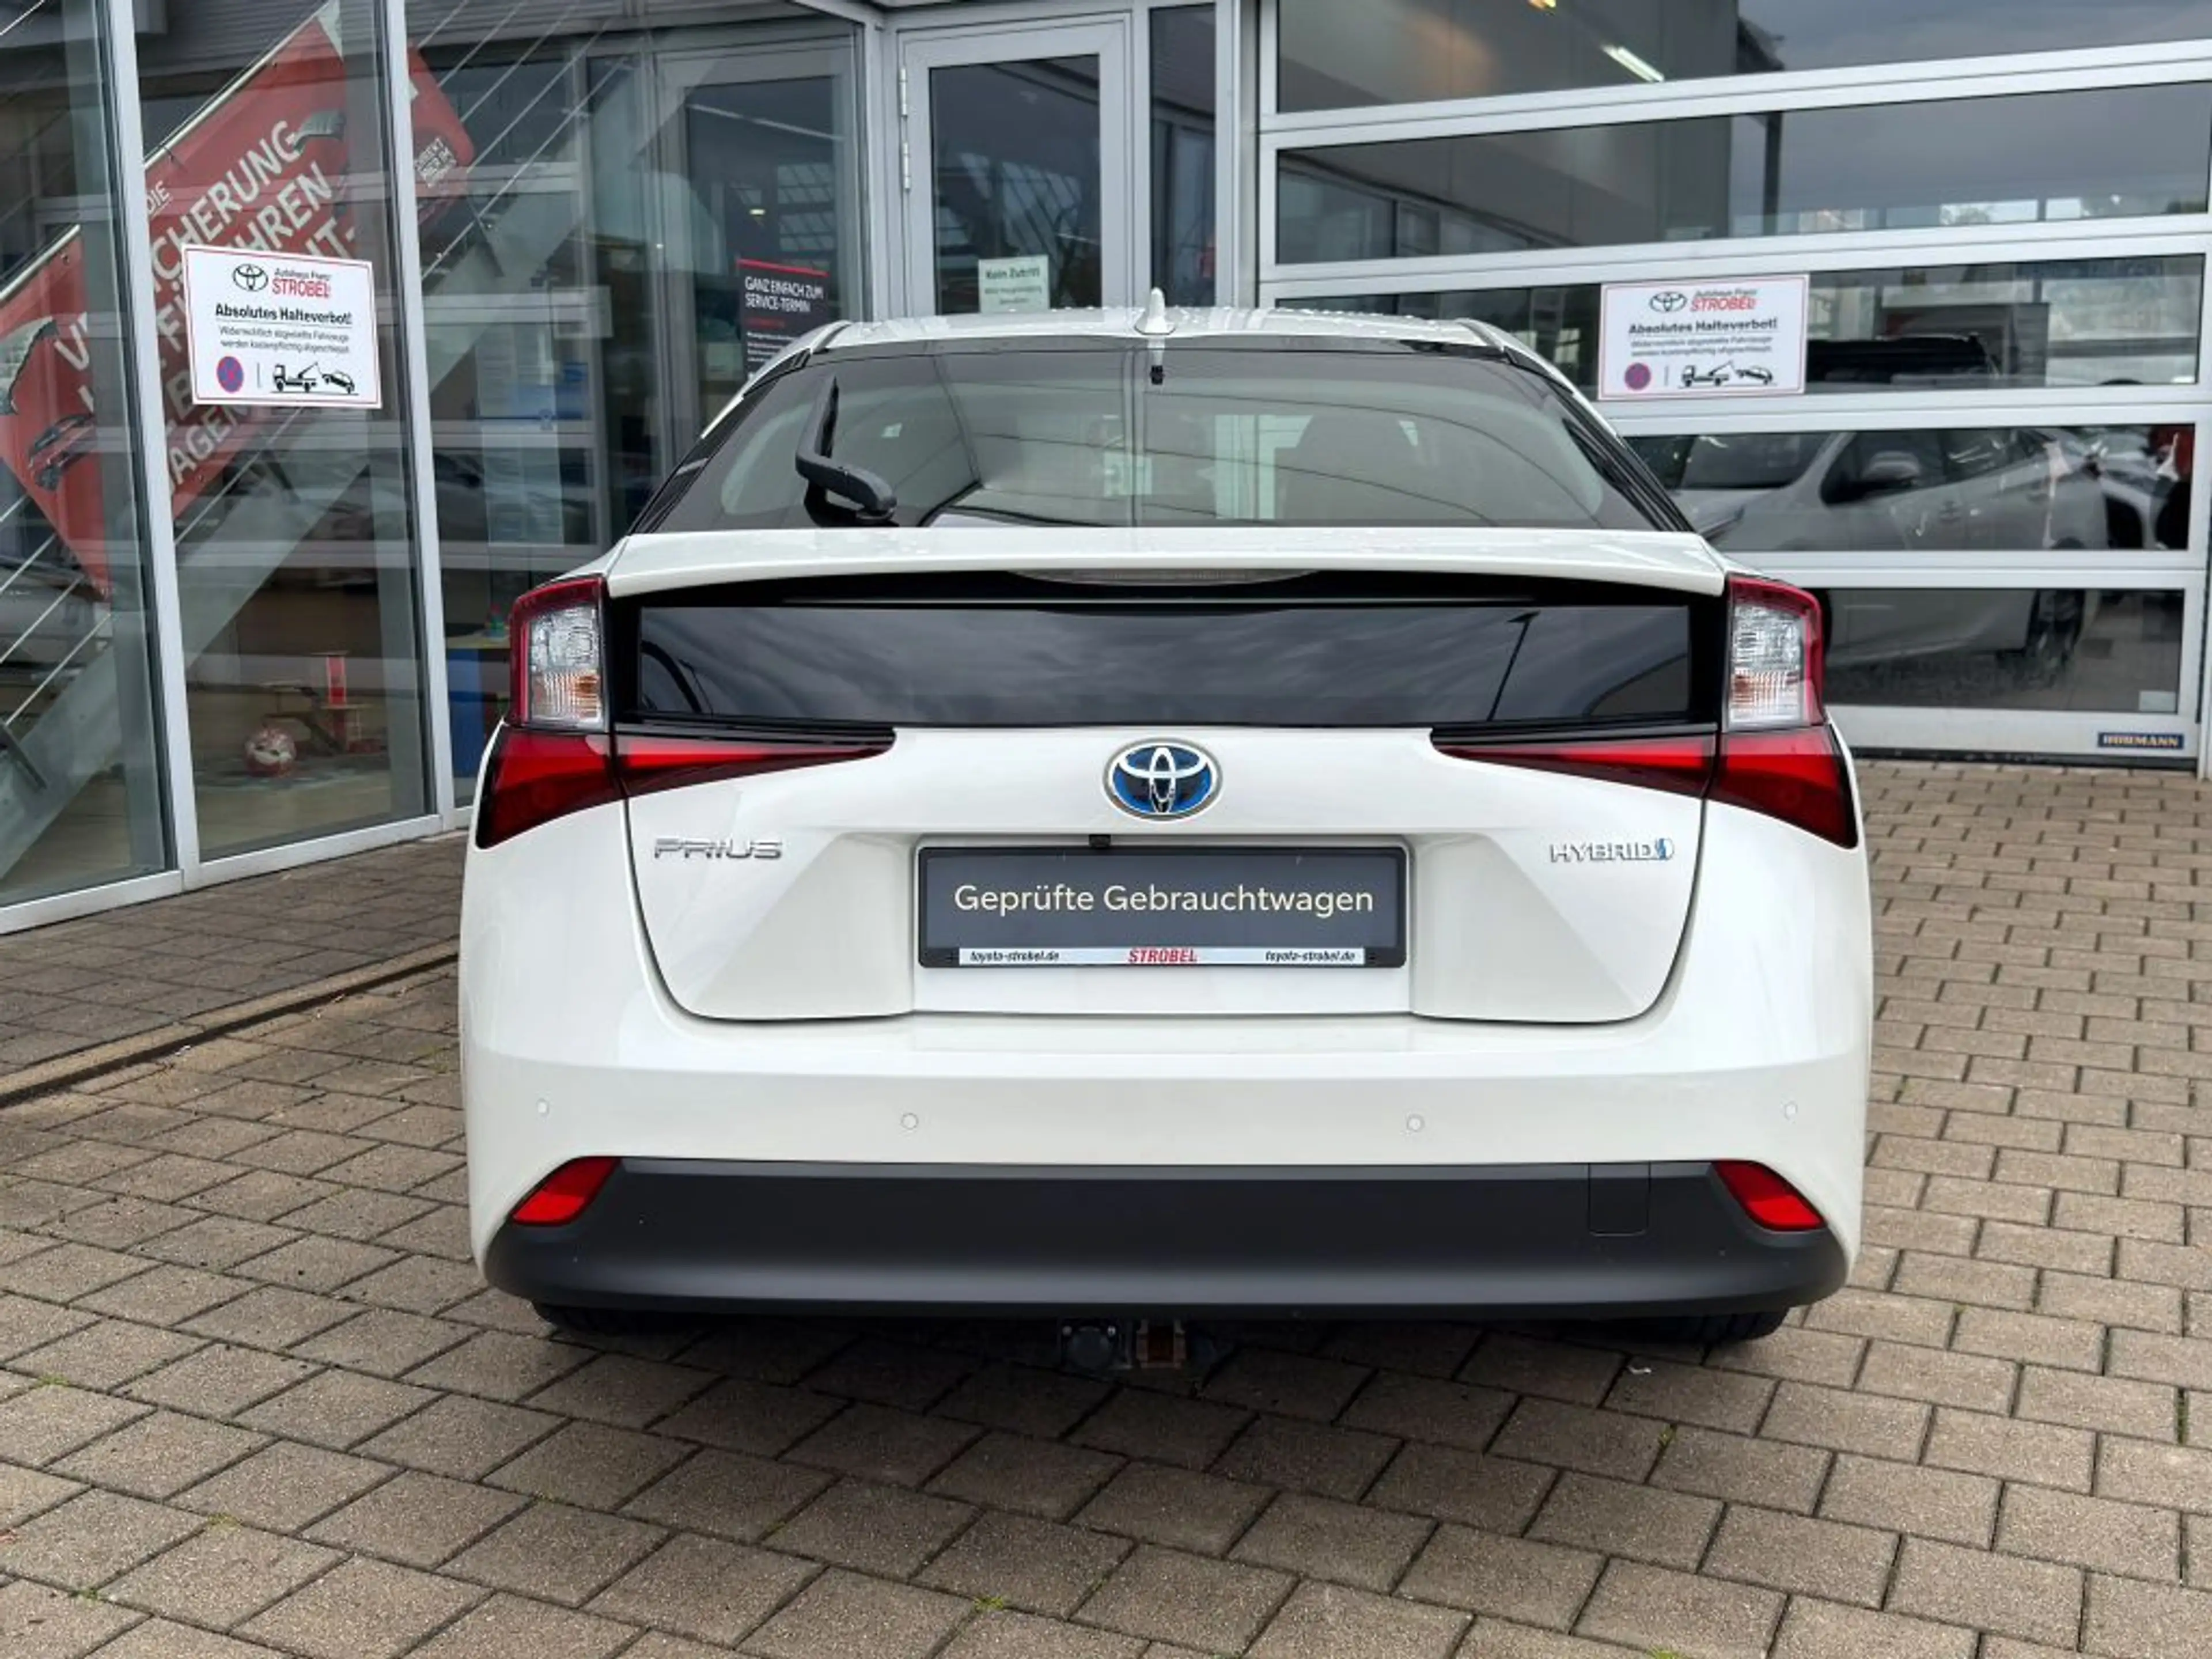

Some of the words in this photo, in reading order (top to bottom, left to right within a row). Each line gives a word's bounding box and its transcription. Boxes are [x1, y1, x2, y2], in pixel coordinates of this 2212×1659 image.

[272, 278, 331, 298] STROBEL
[745, 276, 770, 293] GANZ
[771, 279, 804, 297] EINFACH
[806, 285, 824, 300] ZUM
[745, 292, 811, 313] SERVICE-TERMIN
[1690, 296, 1757, 312] STROBEL
[215, 304, 277, 320] Absolutes
[280, 307, 353, 325] Halteverbot!
[1629, 321, 1692, 334] Absolutes
[1695, 317, 1778, 332] Halteverbot!
[654, 838, 782, 859] PRIUS
[1549, 842, 1654, 863] HYBRID
[955, 884, 1094, 916] Geprüfte
[1103, 884, 1373, 918] Gebrauchtwagen
[970, 950, 1059, 964] toyota-strobel.de
[1127, 948, 1198, 963] STROBEL
[1266, 950, 1355, 963] toyota-strobel.de
